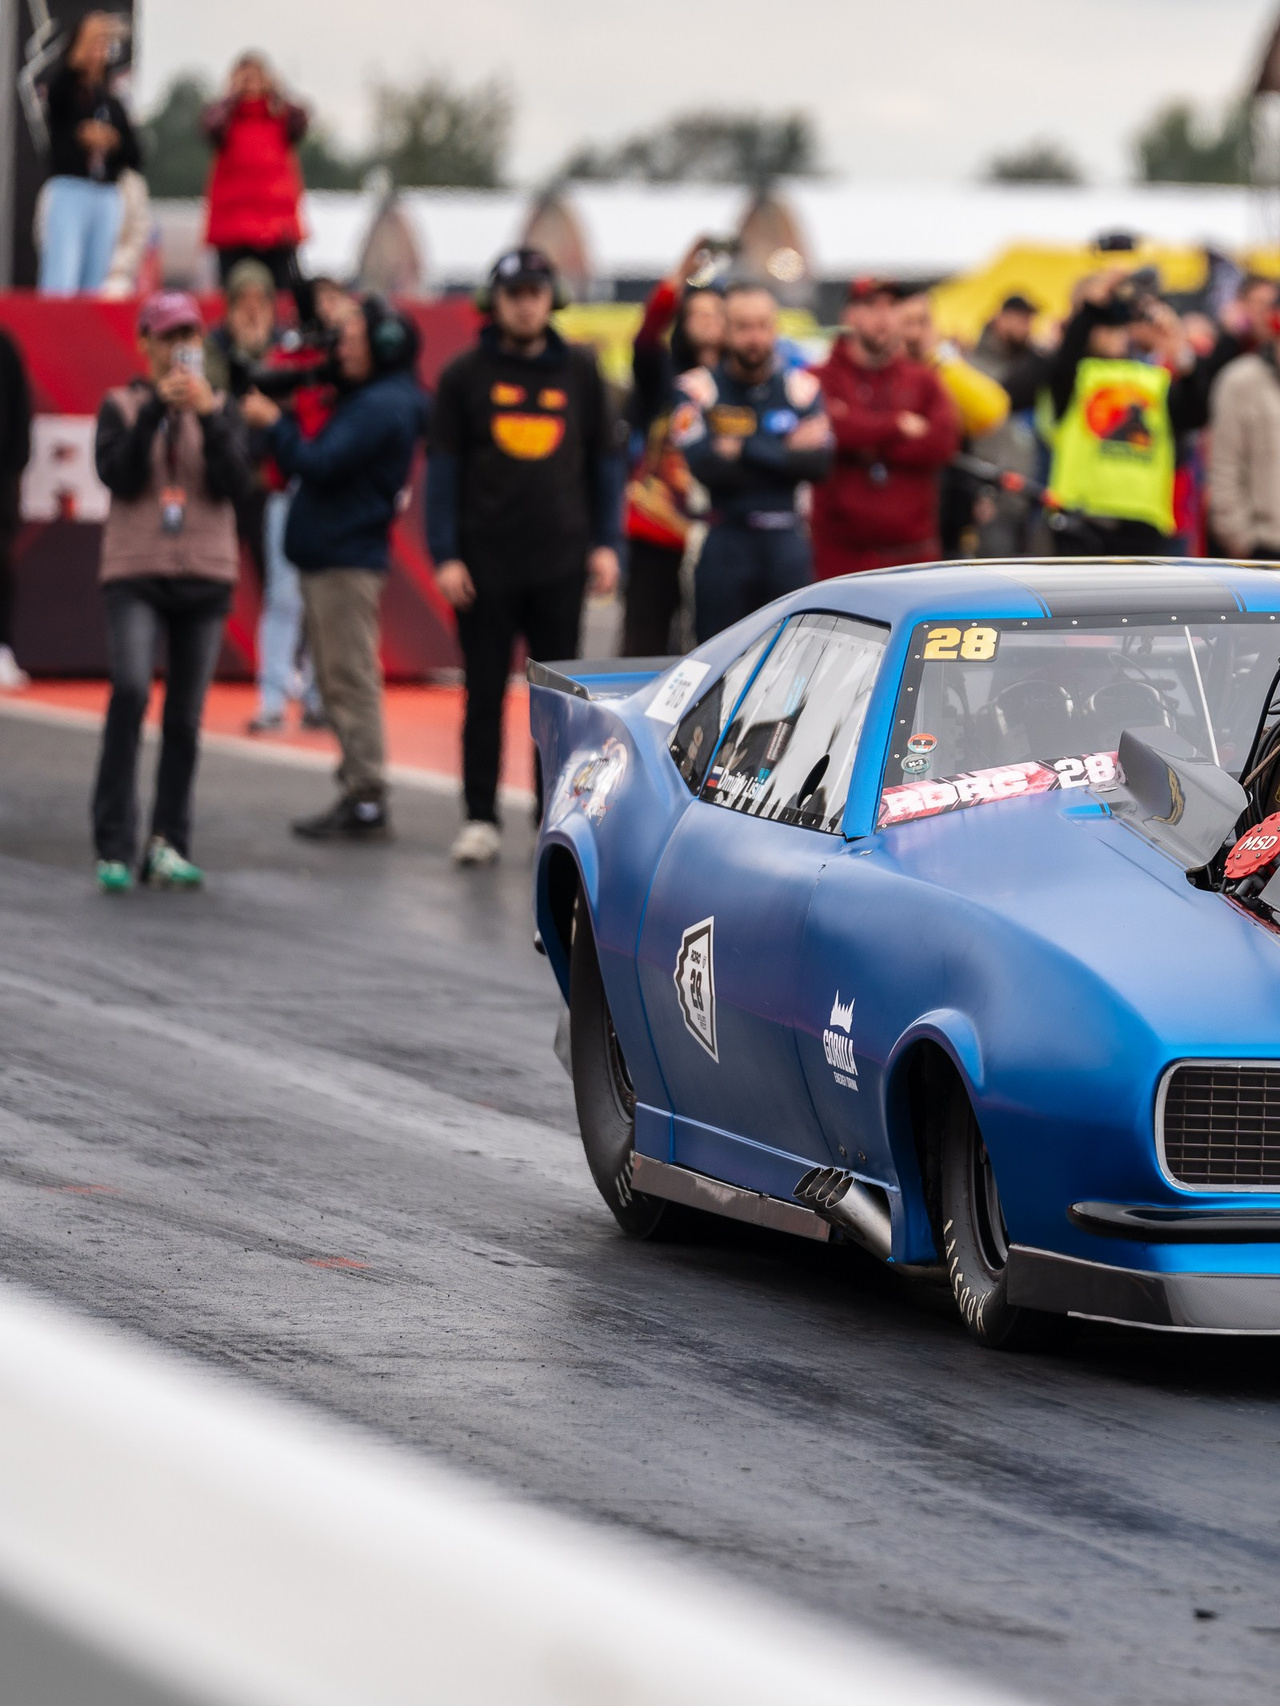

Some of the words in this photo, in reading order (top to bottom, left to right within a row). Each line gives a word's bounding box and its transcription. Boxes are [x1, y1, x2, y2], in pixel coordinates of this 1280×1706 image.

[923, 627, 998, 660] 28
[1053, 755, 1116, 789] 28
[1238, 835, 1279, 851] MSD
[690, 968, 704, 1012] 28
[823, 1028, 859, 1076] GORILLA
